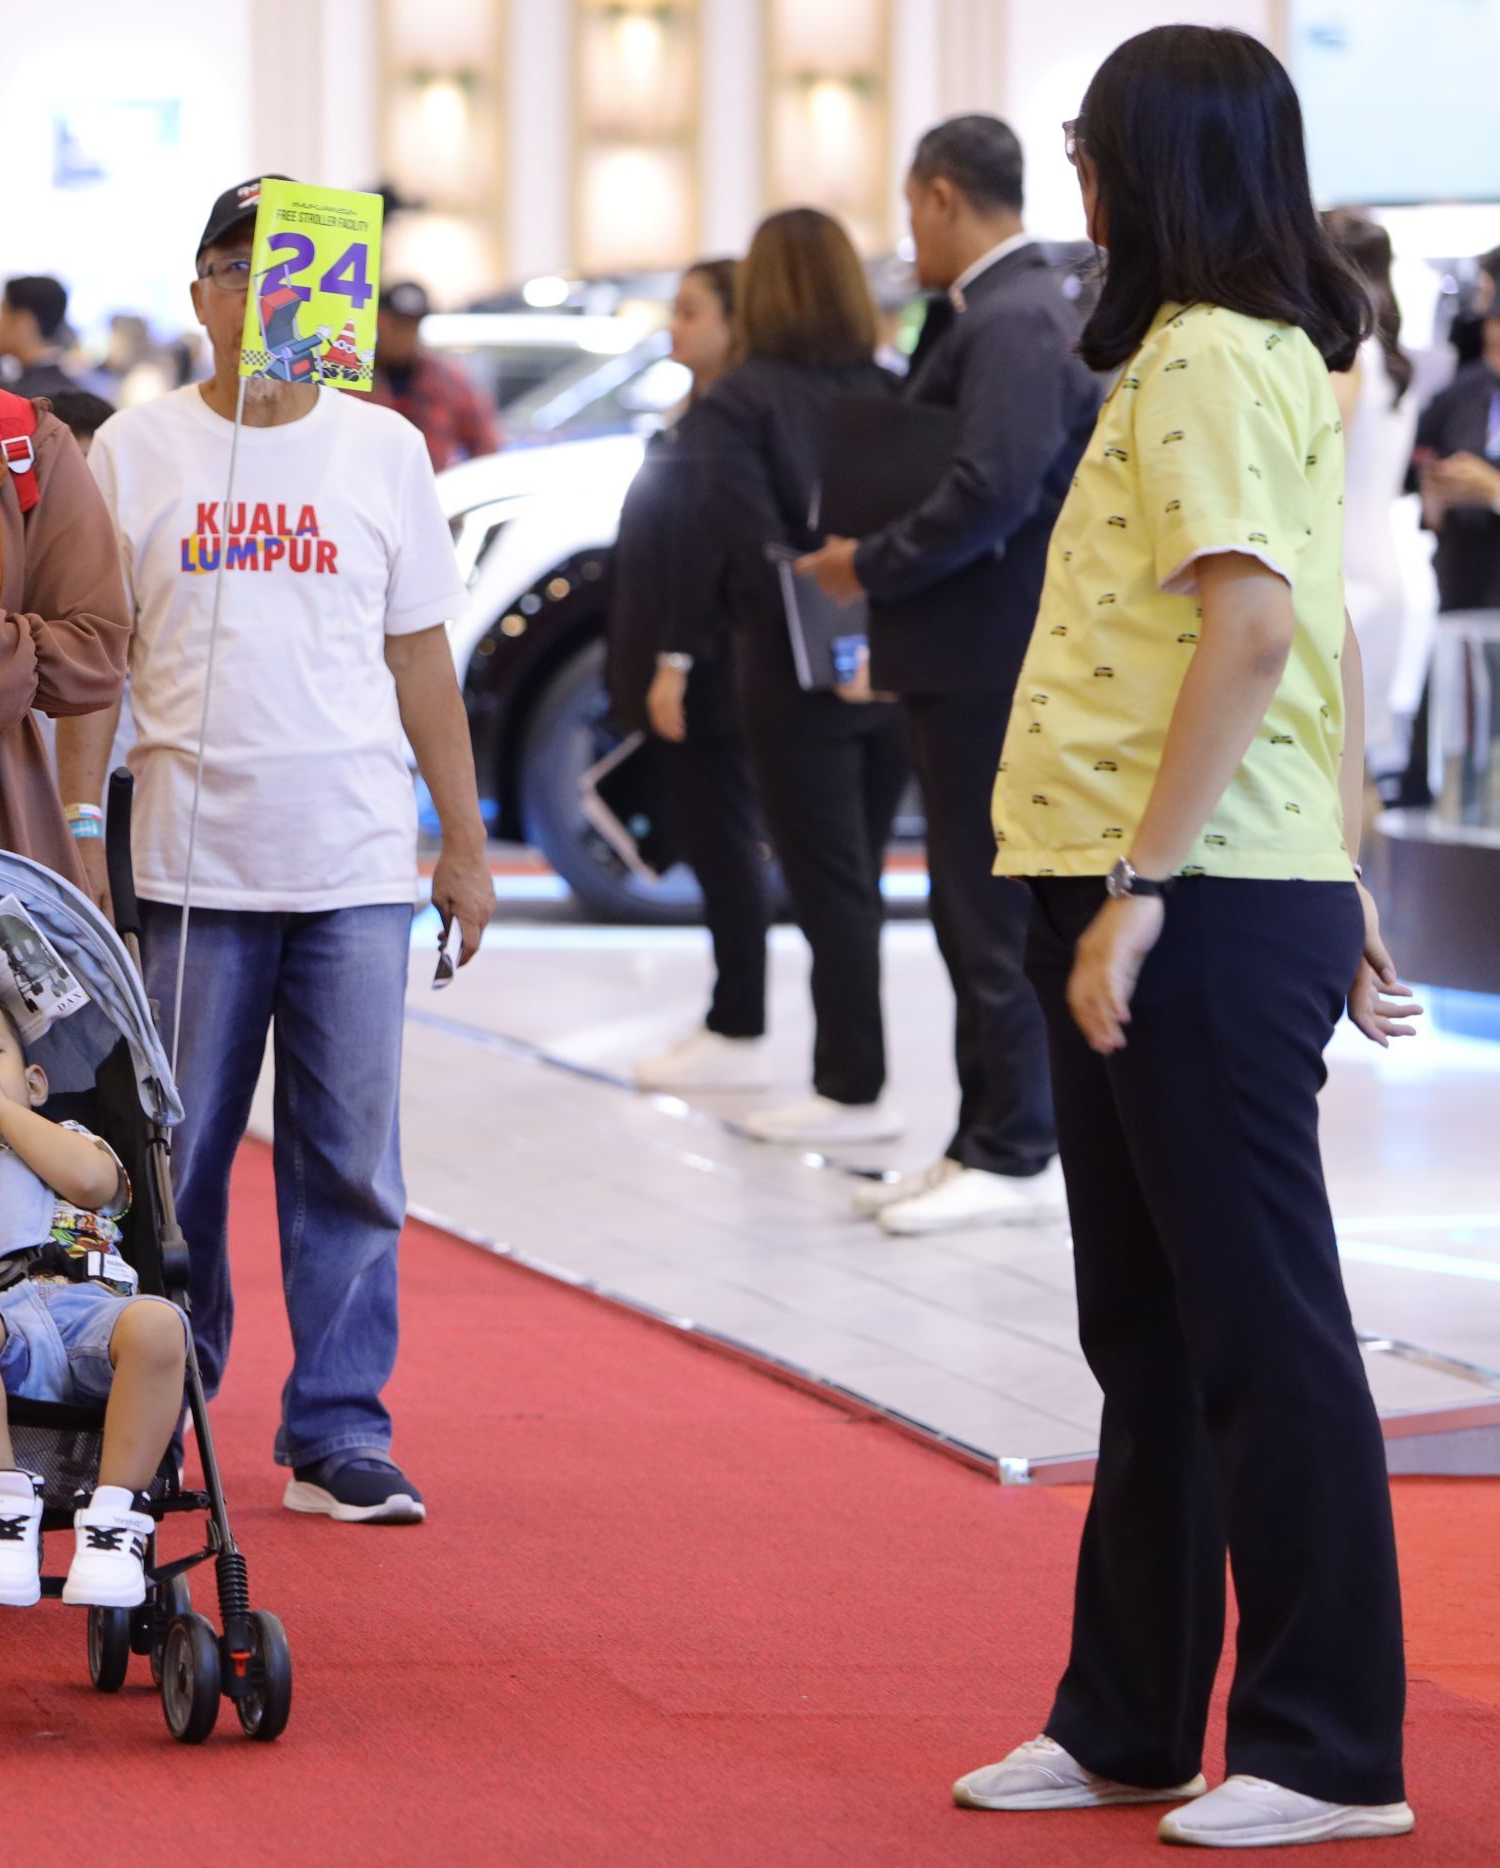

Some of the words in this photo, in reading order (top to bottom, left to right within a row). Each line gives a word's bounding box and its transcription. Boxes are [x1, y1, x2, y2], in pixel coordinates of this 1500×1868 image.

[276, 208, 297, 222] FREE
[298, 211, 336, 227] STROLLER
[338, 217, 369, 232] FACILITY
[260, 232, 373, 309] 24
[197, 502, 320, 537] KUALA
[181, 537, 339, 574] LUMPUR
